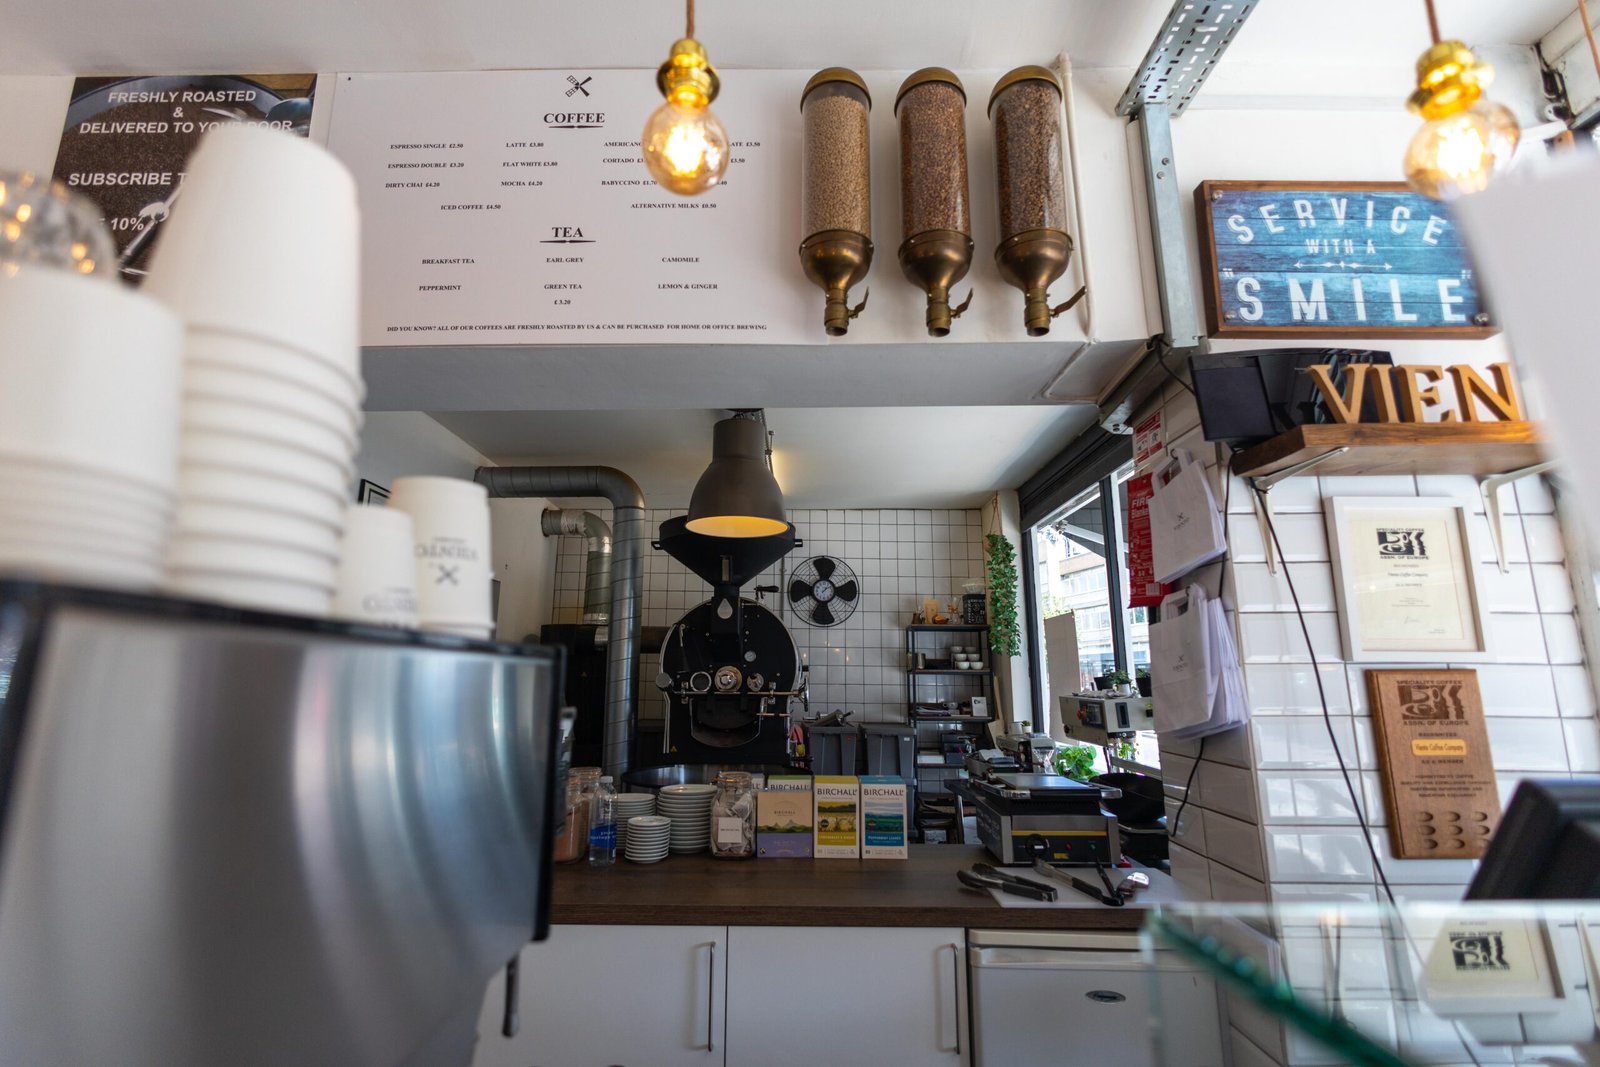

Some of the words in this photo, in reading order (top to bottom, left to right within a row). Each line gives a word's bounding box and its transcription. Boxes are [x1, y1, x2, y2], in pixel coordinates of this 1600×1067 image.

[108, 92, 179, 102] FRESHLY
[182, 91, 256, 101] ROASTED
[173, 107, 183, 118] &
[544, 112, 605, 124] COFFEE
[80, 123, 168, 133] DELIVERED
[174, 122, 193, 133] TO
[68, 173, 171, 185] SUBSCRIBE
[110, 218, 144, 230] 10%
[1227, 198, 1447, 245] SERVICE
[552, 227, 583, 237] TEA
[1306, 239, 1354, 254] WITH
[1367, 240, 1375, 254] A
[864, 788, 903, 796] BIRCHALL
